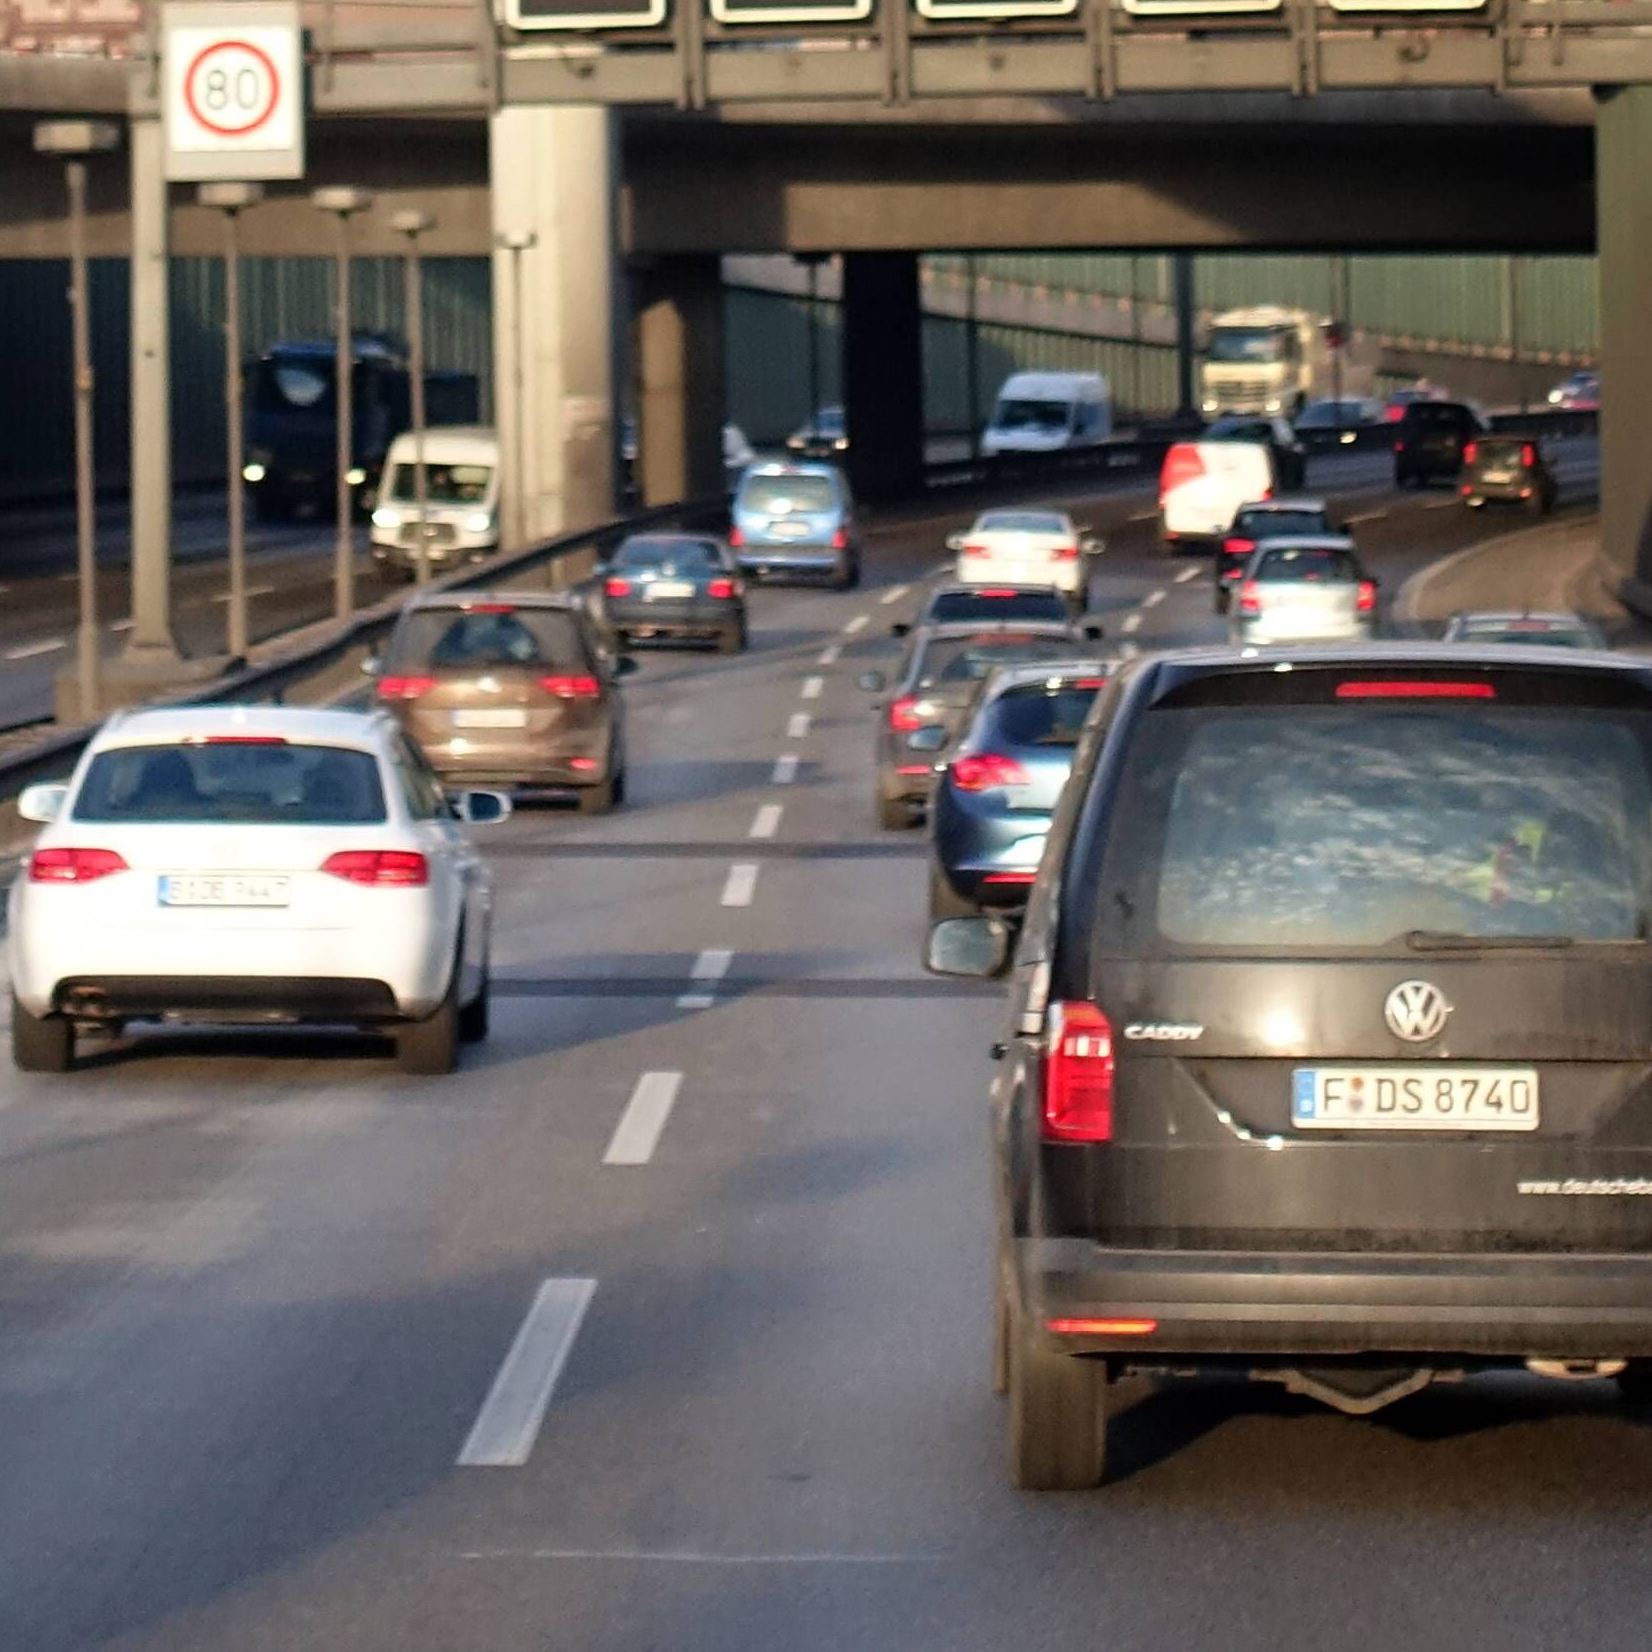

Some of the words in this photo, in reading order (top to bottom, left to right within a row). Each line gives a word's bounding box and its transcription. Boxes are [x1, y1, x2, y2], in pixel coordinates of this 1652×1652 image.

[205, 68, 260, 111] 80
[1124, 1026, 1204, 1041] CADDY
[1323, 1078, 1345, 1112] F
[1375, 1078, 1424, 1114] DS
[1434, 1078, 1531, 1115] 8740
